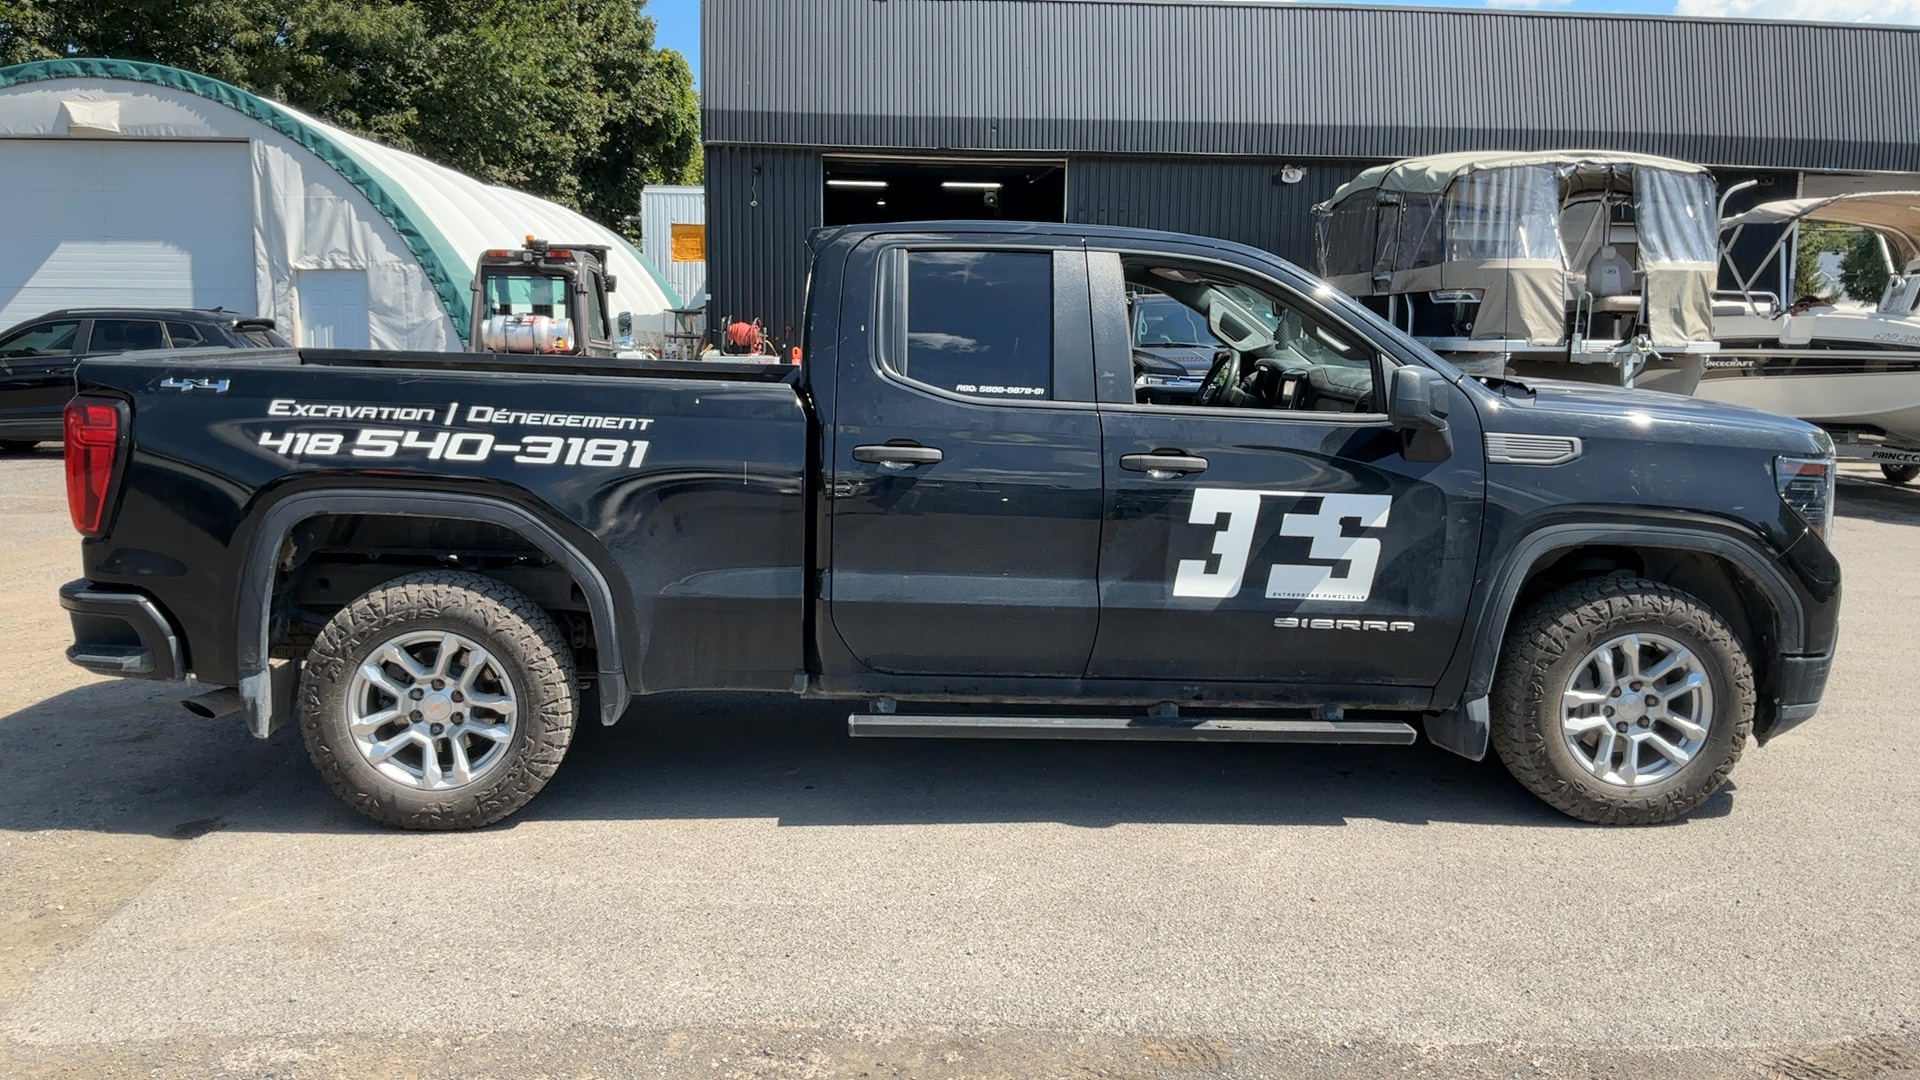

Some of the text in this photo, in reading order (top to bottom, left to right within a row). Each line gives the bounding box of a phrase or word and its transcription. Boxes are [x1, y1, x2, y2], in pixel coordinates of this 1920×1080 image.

[258, 429, 650, 469] 418 540-3181
[1872, 451, 1920, 462] PRINCEC
[1273, 617, 1415, 632] SIERRA
